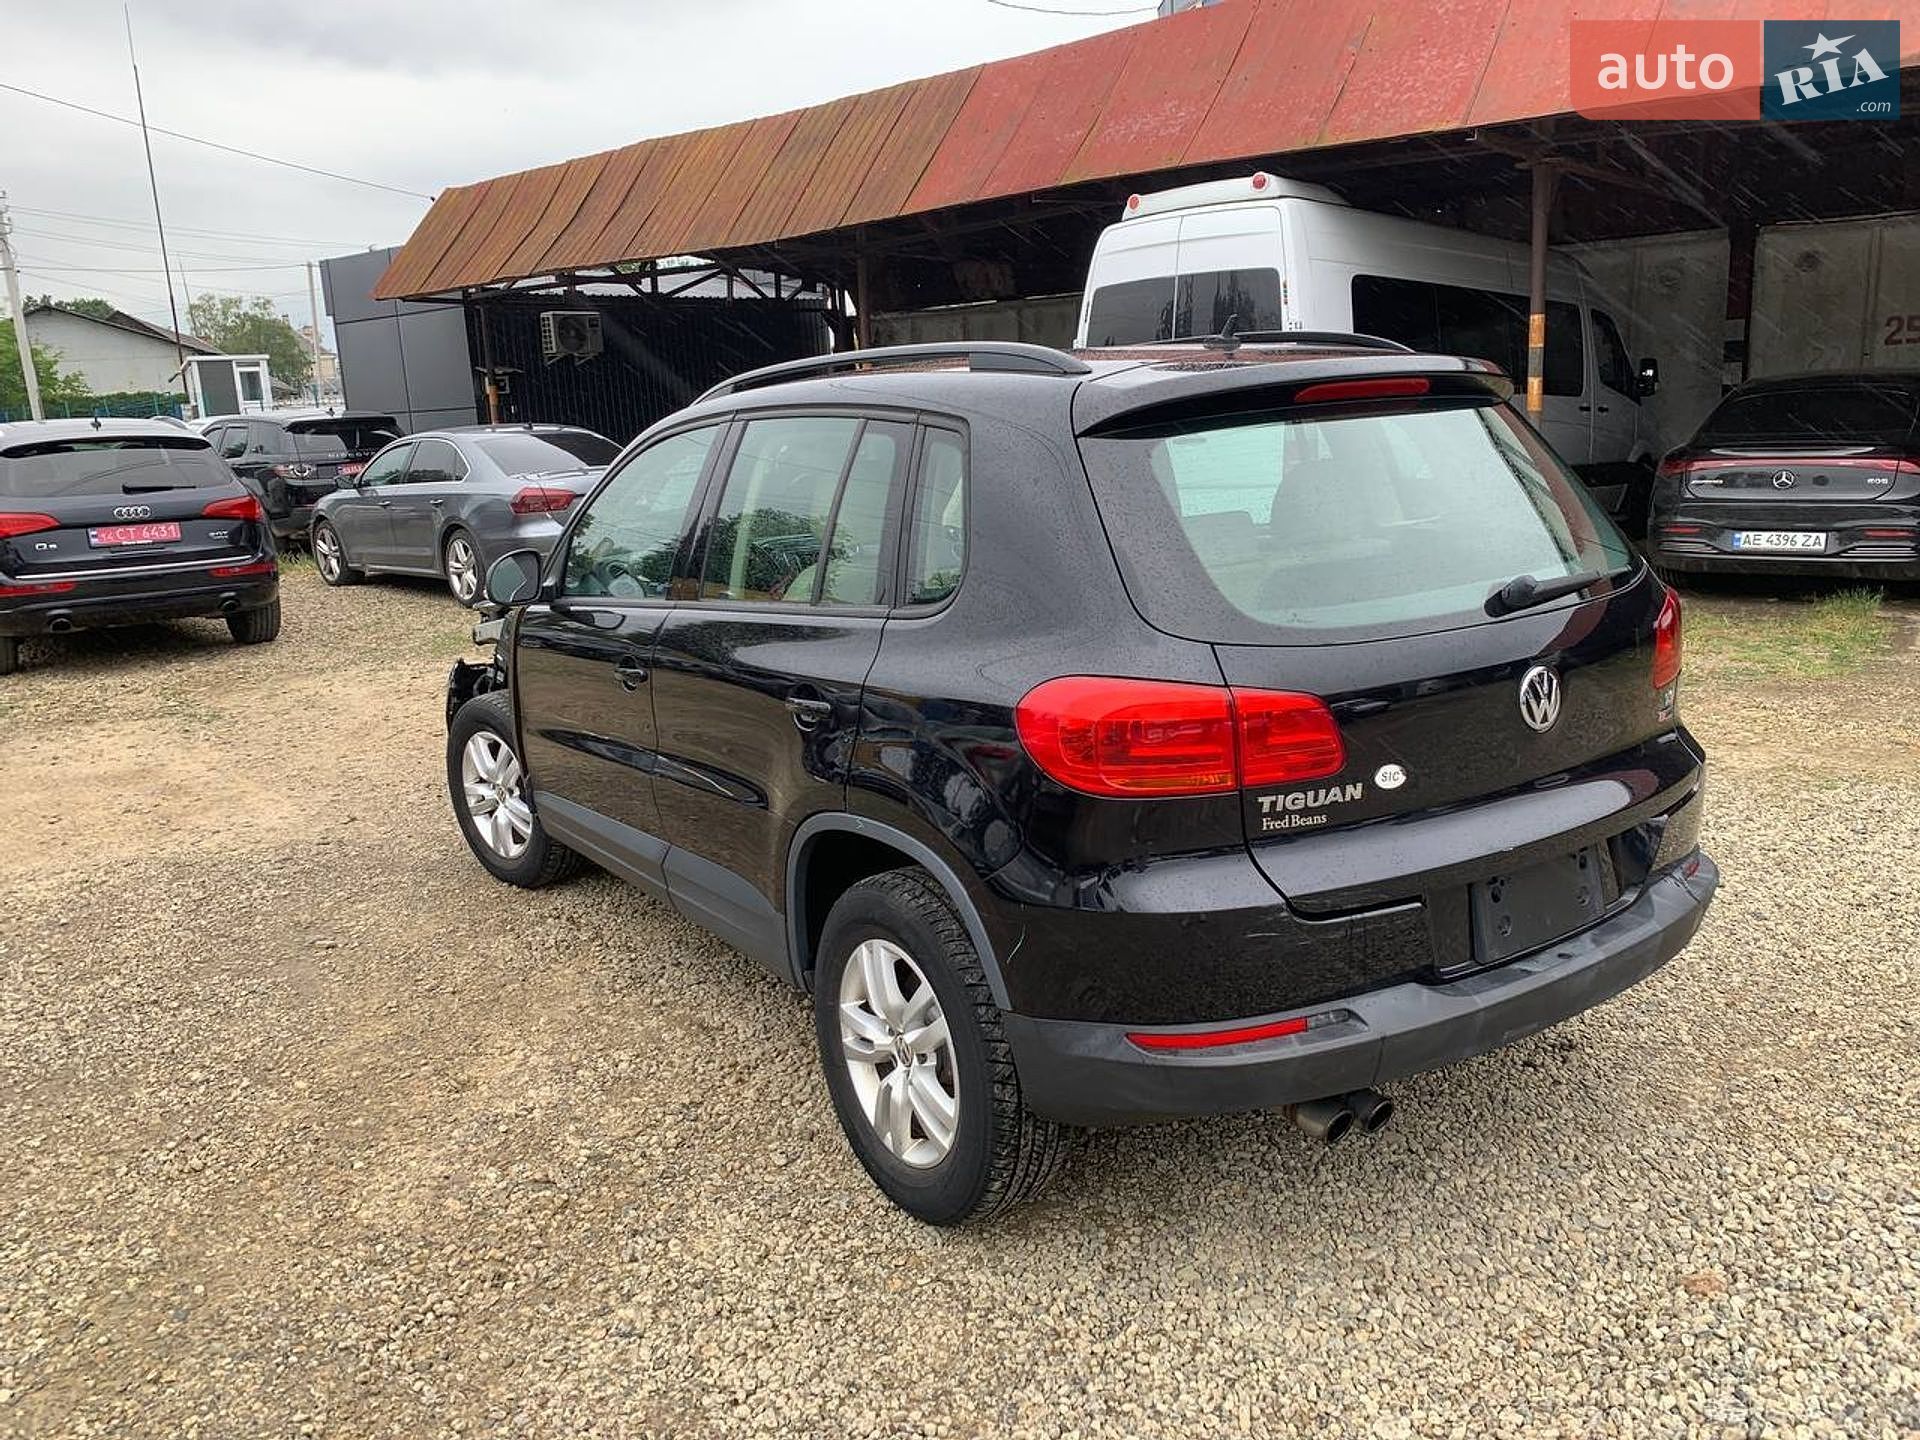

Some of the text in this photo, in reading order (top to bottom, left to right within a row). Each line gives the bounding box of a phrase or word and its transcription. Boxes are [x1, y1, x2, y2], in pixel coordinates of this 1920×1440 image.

[1741, 534, 1823, 548] AE 4396 ZA
[1380, 771, 1401, 783] SIC
[1257, 782, 1364, 814] TIGUAN
[1262, 814, 1327, 831] Fred Beans
